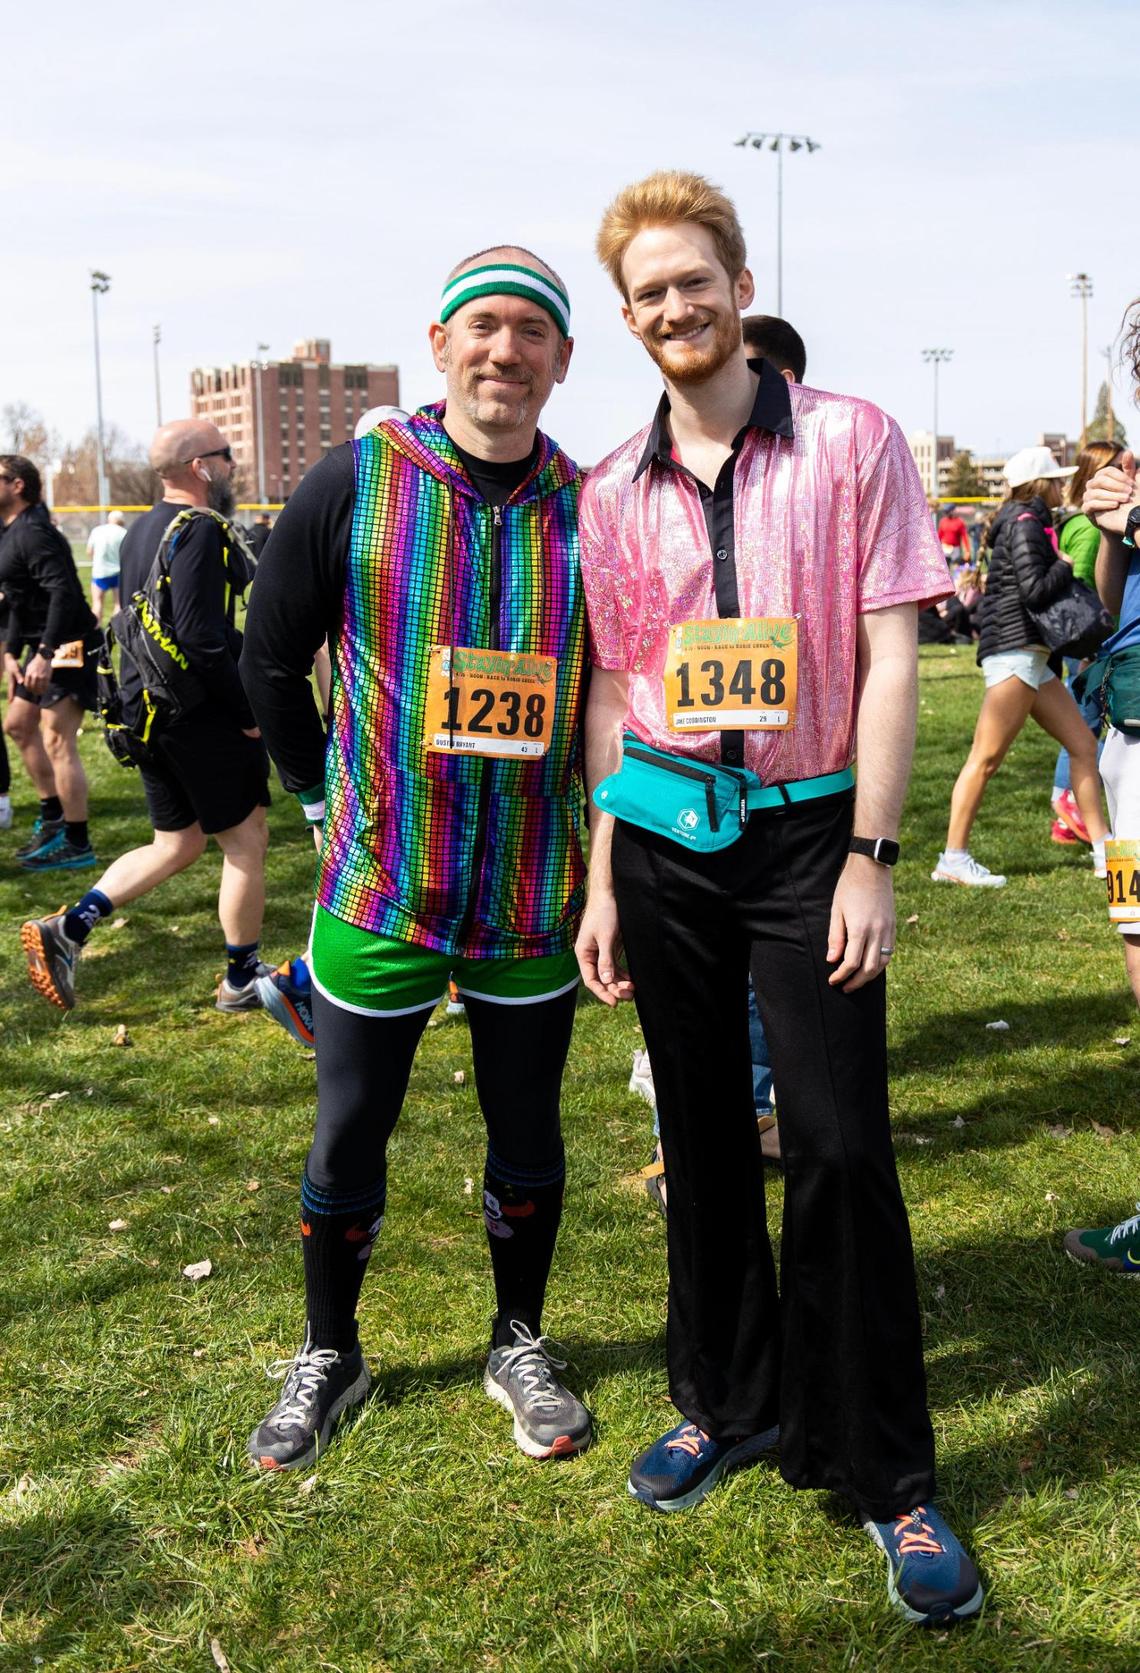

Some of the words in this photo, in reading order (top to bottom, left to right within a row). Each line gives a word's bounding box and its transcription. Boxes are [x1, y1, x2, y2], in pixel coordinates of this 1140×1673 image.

[138, 601, 189, 670] NATHAN
[676, 659, 786, 707] 1348
[441, 687, 546, 737] 1238
